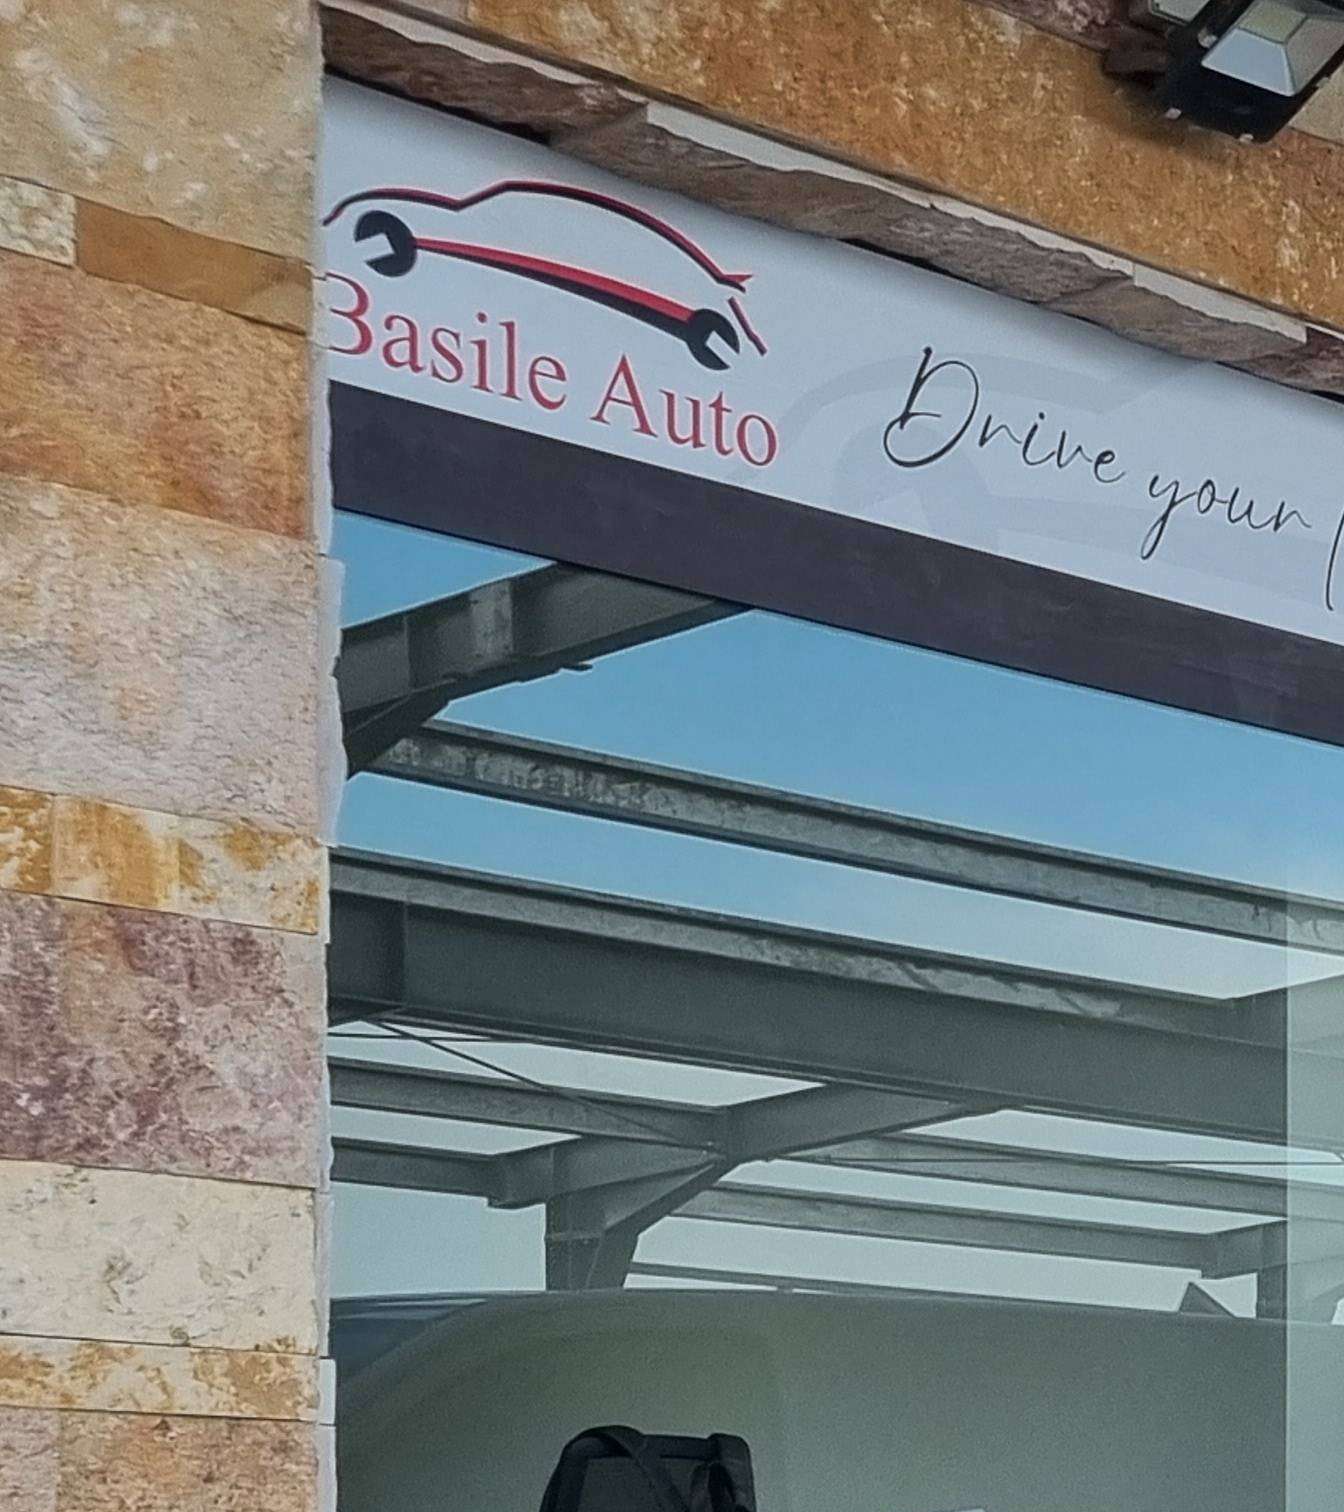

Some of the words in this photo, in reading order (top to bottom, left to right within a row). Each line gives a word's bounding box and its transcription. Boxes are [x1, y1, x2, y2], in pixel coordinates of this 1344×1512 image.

[590, 353, 778, 467] Auto
[883, 346, 1126, 485] Drive
[1140, 470, 1313, 560] your
